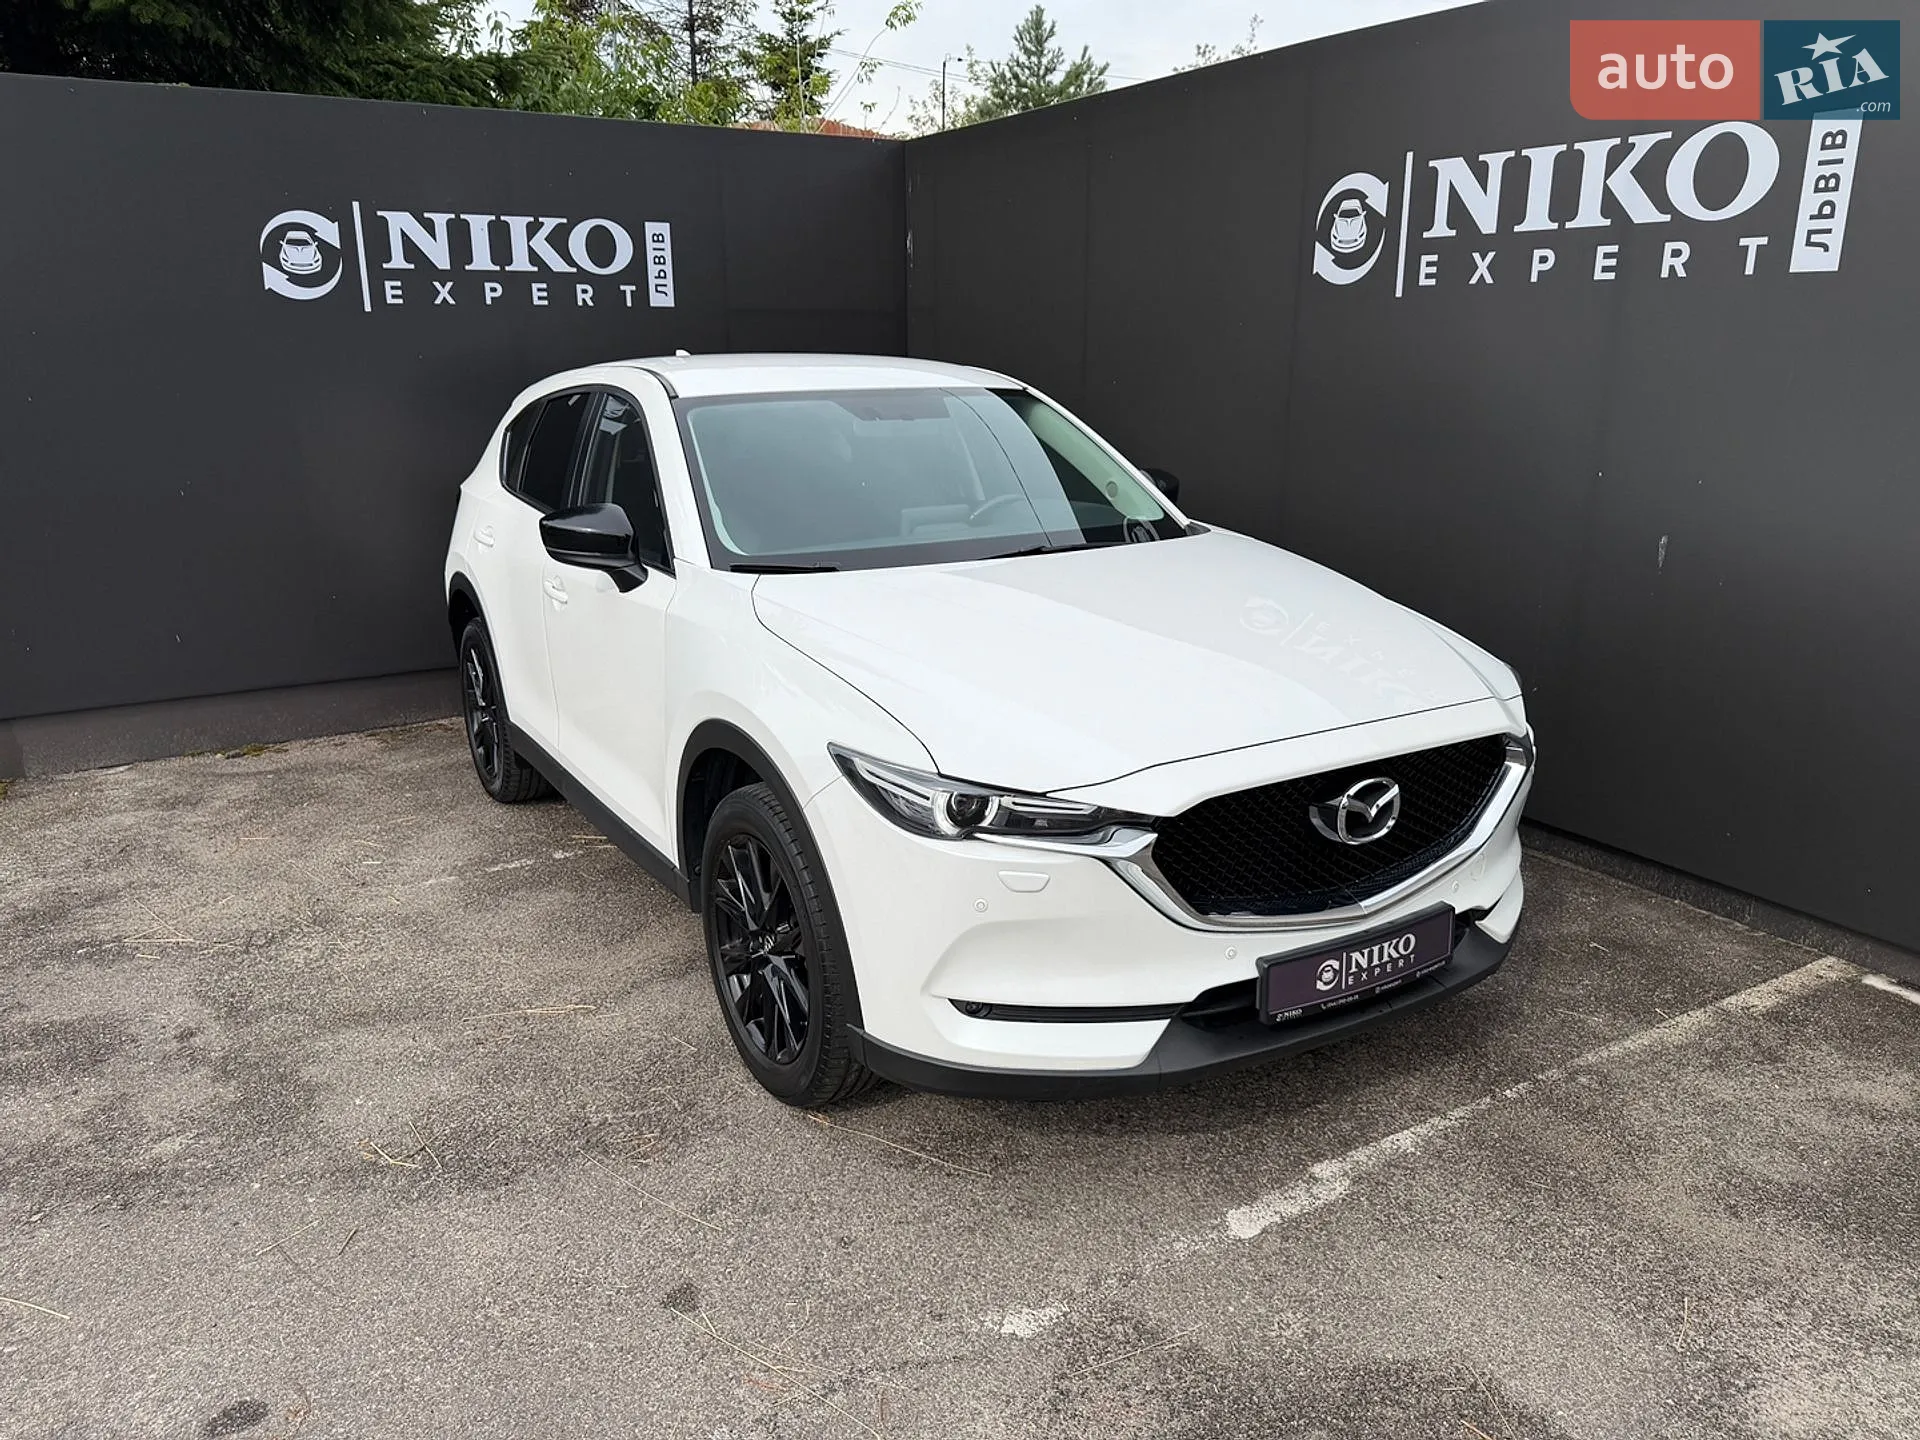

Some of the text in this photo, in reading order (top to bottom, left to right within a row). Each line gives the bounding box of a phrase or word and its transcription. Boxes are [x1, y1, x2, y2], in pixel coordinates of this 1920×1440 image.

[1422, 121, 1780, 238] NIKO
[376, 210, 634, 275] NIKO
[1418, 236, 1769, 287] EXPERT
[384, 280, 637, 308] EXPERT
[1348, 954, 1416, 985] EXPERT
[1349, 933, 1416, 974] NIKO
